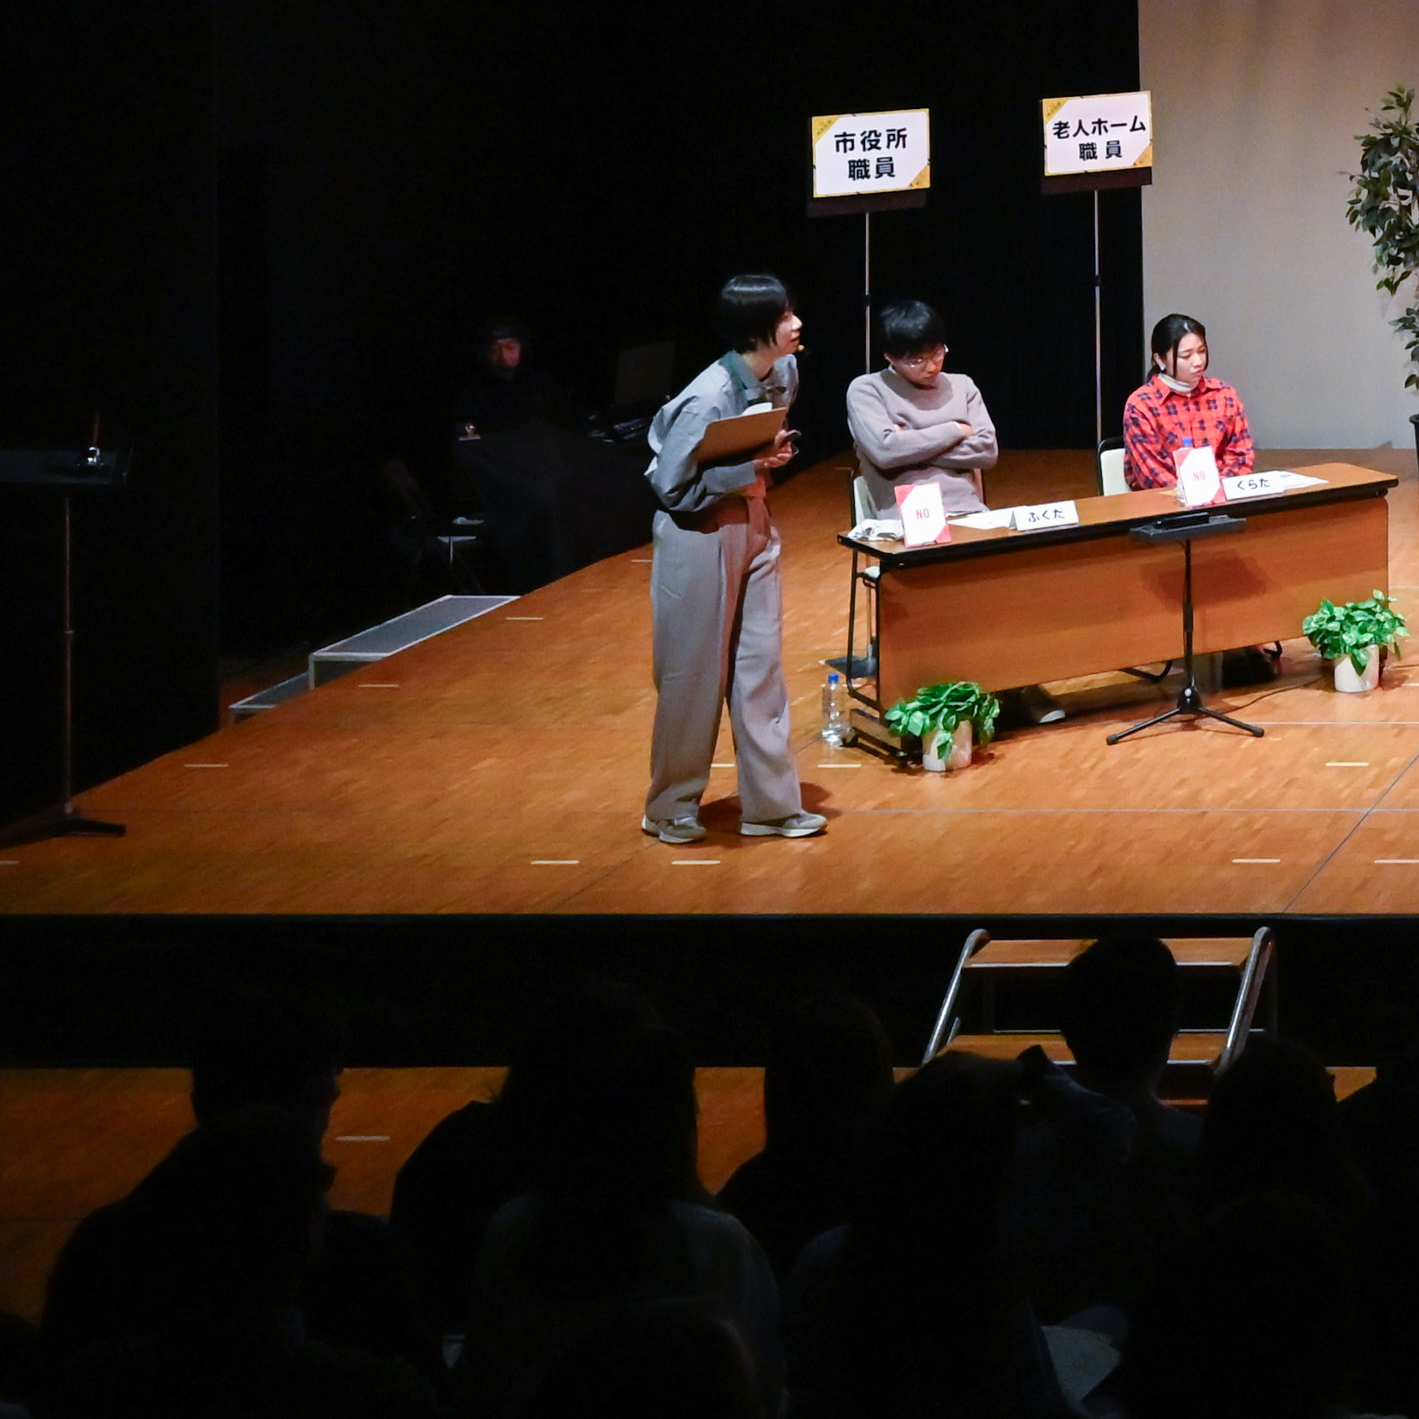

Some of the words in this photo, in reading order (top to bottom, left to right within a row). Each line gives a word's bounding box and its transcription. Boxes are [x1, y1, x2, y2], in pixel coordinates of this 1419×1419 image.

[1052, 115, 1147, 140] 老人ホーム
[834, 127, 908, 154] 市役所
[1079, 140, 1123, 162] 職員
[847, 157, 896, 182] 職員
[1193, 471, 1206, 481] NO
[1237, 477, 1271, 490] くらた
[915, 509, 930, 519] NO
[1028, 508, 1066, 523] ふくだ
